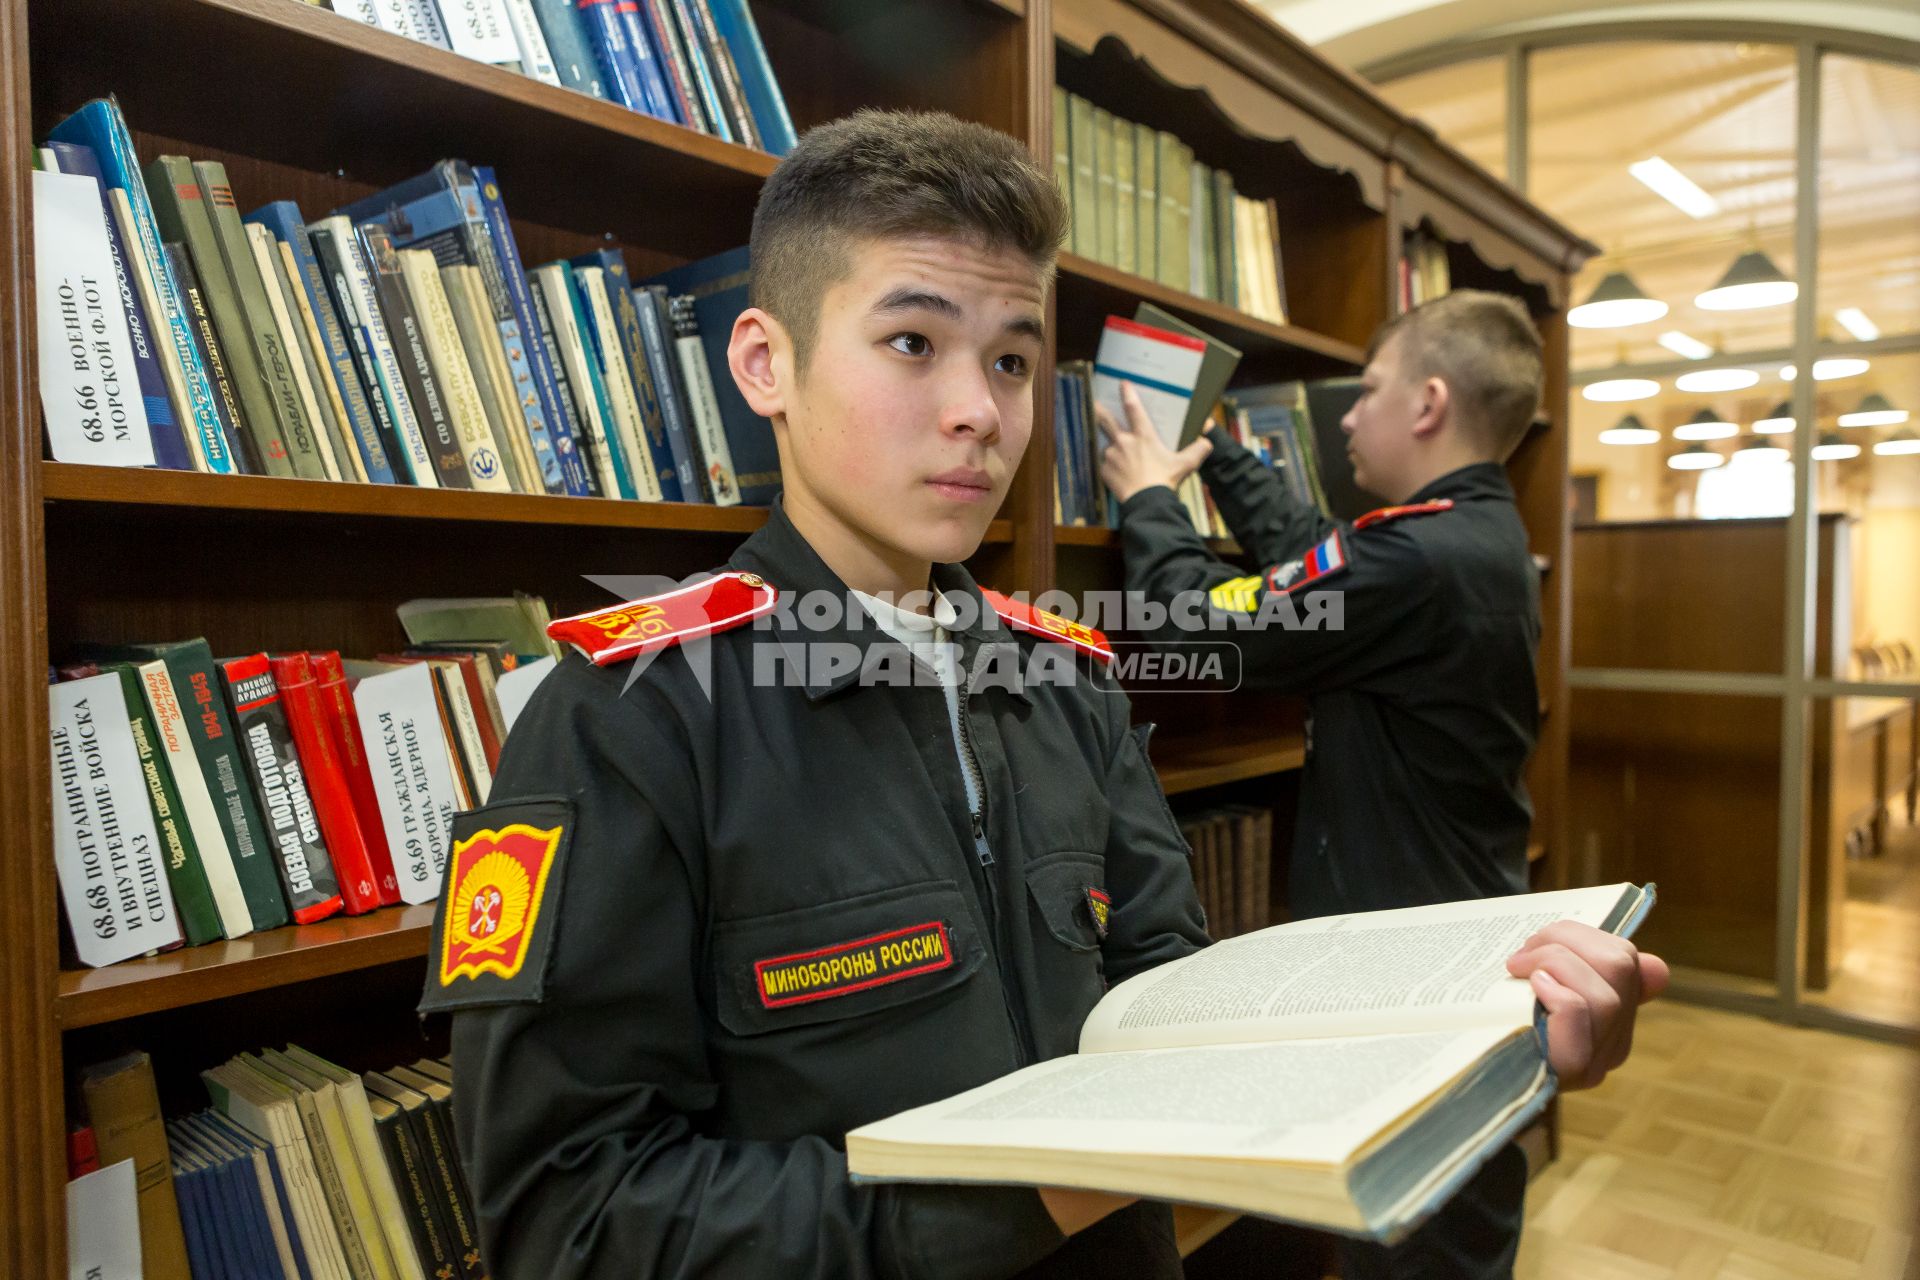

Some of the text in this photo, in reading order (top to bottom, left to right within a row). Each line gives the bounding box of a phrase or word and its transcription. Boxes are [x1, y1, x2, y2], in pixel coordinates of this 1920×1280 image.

[83, 276, 108, 333] ФЛОТ
[347, 236, 364, 272] ФЛОТ
[58, 277, 105, 443] 68.66 ВОЕННО-
[359, 276, 386, 343] СЕВЕРНЫЙ
[94, 334, 131, 440] МОРСКОЙ
[264, 331, 310, 454] КОРАБЛИ-ГЕРОИ
[371, 386, 390, 428] ГИБЕЛЬ
[383, 348, 425, 462] КРАСНОЗНАМЕННЫЙ
[403, 316, 449, 444] СТО ВЕЛИКИХ АДМИРАЛОВ
[454, 393, 475, 442] БОЕВОЙ
[146, 672, 179, 753] ПОГРАНИЧНАЯ
[159, 672, 181, 722] ЗАСТАВА
[51, 727, 117, 940] 68.68 ПОГРАНИЧНЫЕ
[74, 698, 143, 931] И ВНУТРЕННИЕ ВОЙСКА
[130, 717, 186, 869] Часовые советских границ
[213, 754, 253, 857] ПОГРАНИЧНЫЕ ВОЙСКА
[248, 722, 313, 894] БОЕВАЯ ПОДГОТОВКА
[283, 760, 319, 843] СПЕЦНАЗА
[379, 712, 427, 881] 68.69 ГРАЖДАНСКАЯ
[402, 718, 445, 873] ОБОРОНА. ЯДЕРНОЕ
[131, 834, 166, 923] СПЕЦНАЗ
[763, 933, 944, 995] МИНОБОРОНЫ РОССИИ
